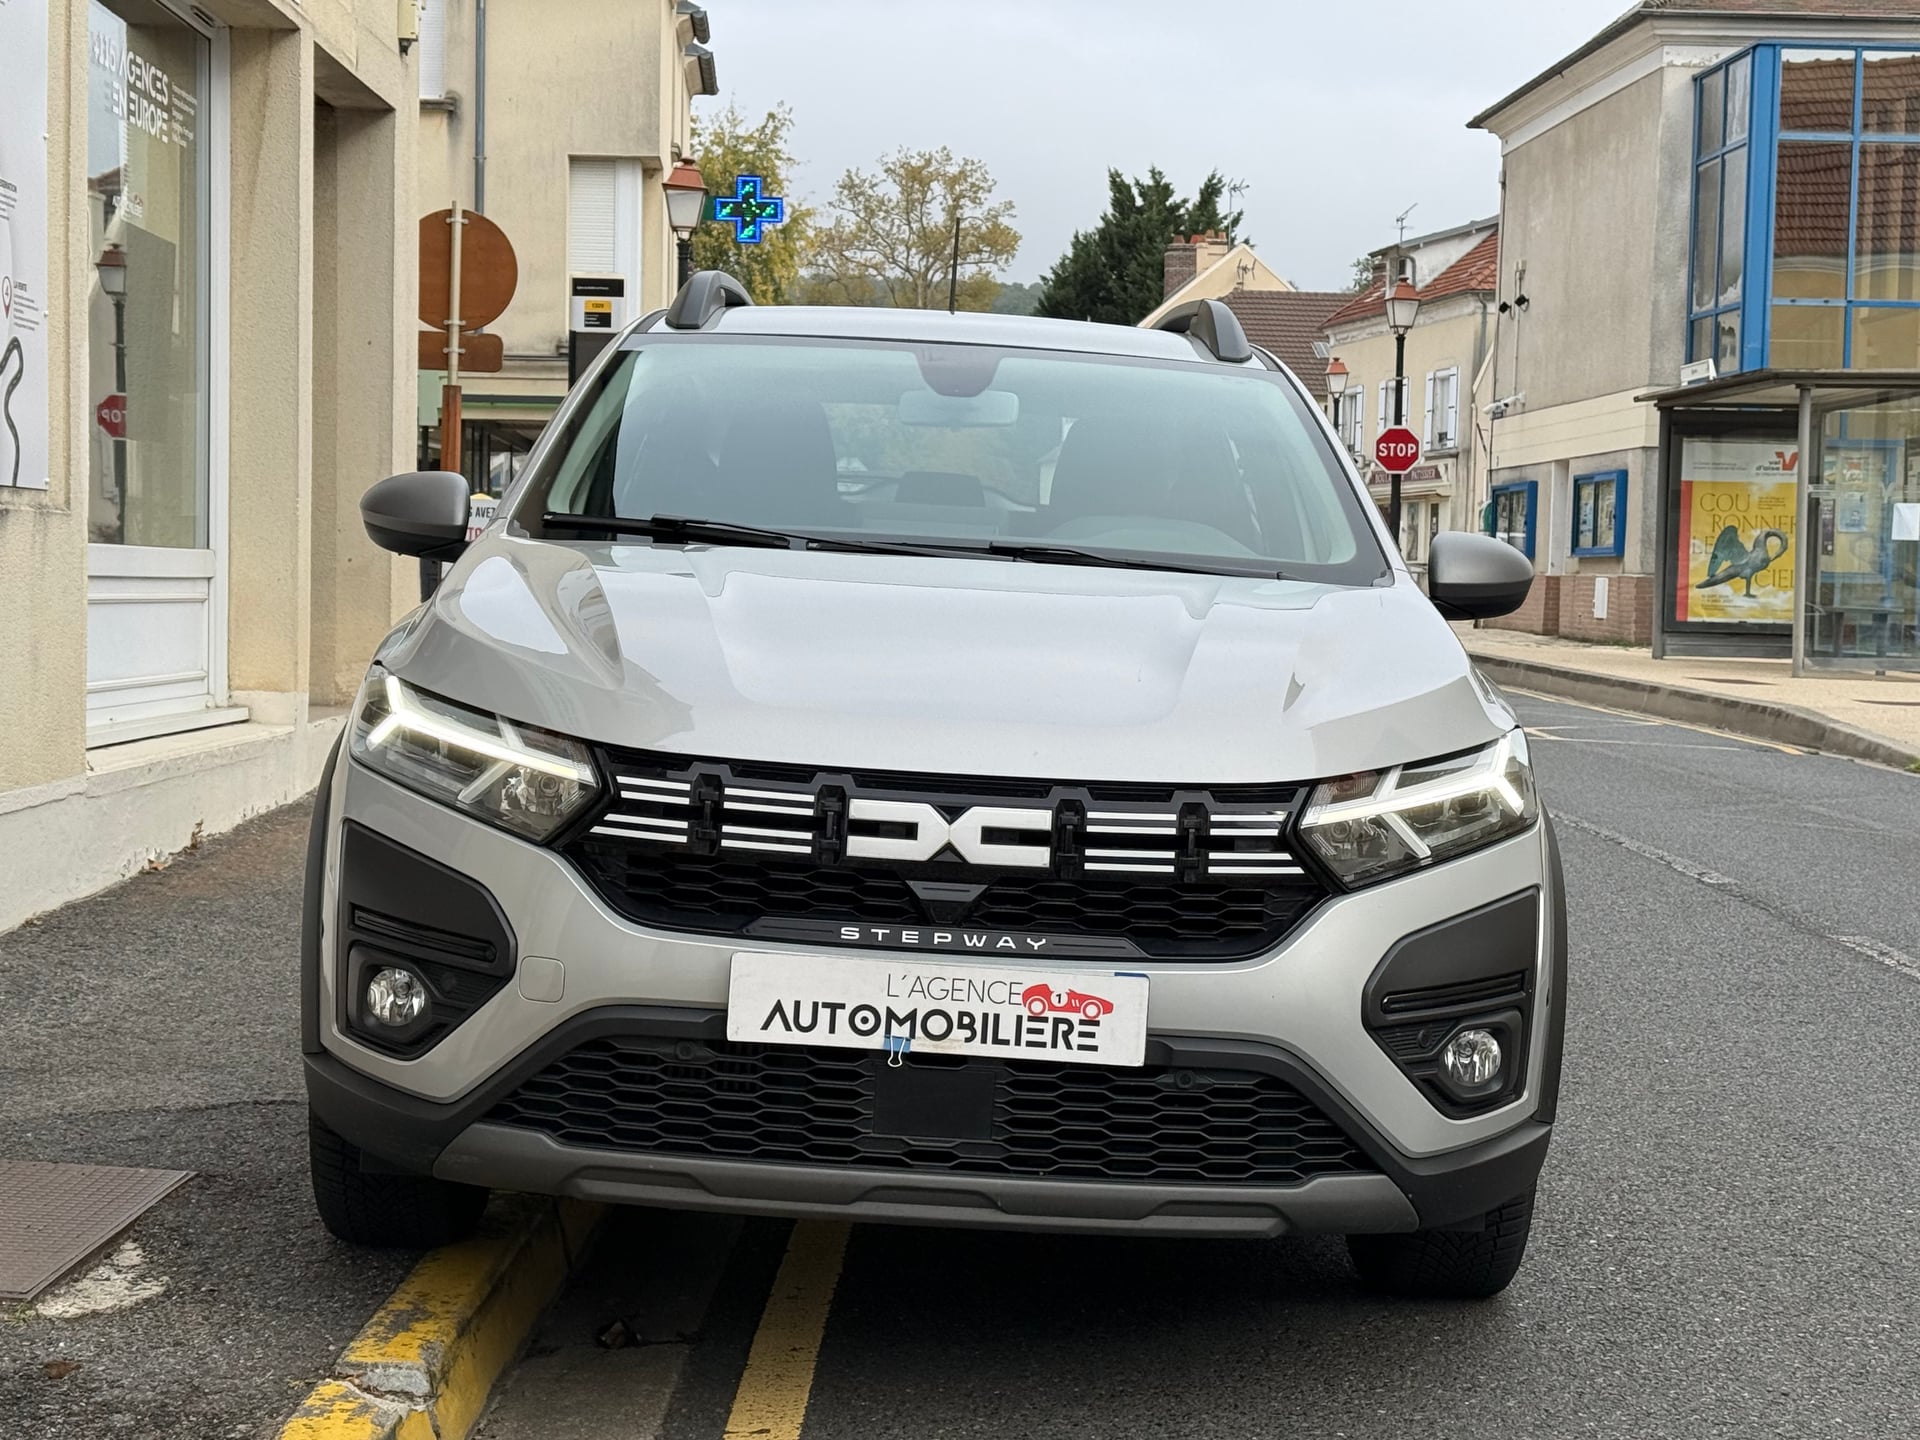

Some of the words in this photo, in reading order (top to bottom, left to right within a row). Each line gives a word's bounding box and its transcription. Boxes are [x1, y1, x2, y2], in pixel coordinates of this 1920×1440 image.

[119, 47, 168, 106] AGENCES
[112, 80, 127, 120] EN
[129, 90, 168, 144] EUROPE
[1378, 443, 1417, 457] STOP
[1700, 493, 1751, 513] COU
[1692, 535, 1715, 555] LE
[840, 926, 1047, 951] STEPWAY
[887, 973, 1023, 1006] L'AGENCE
[1055, 993, 1063, 1004] 1
[760, 999, 1101, 1052] AUTOMOBILIERE
